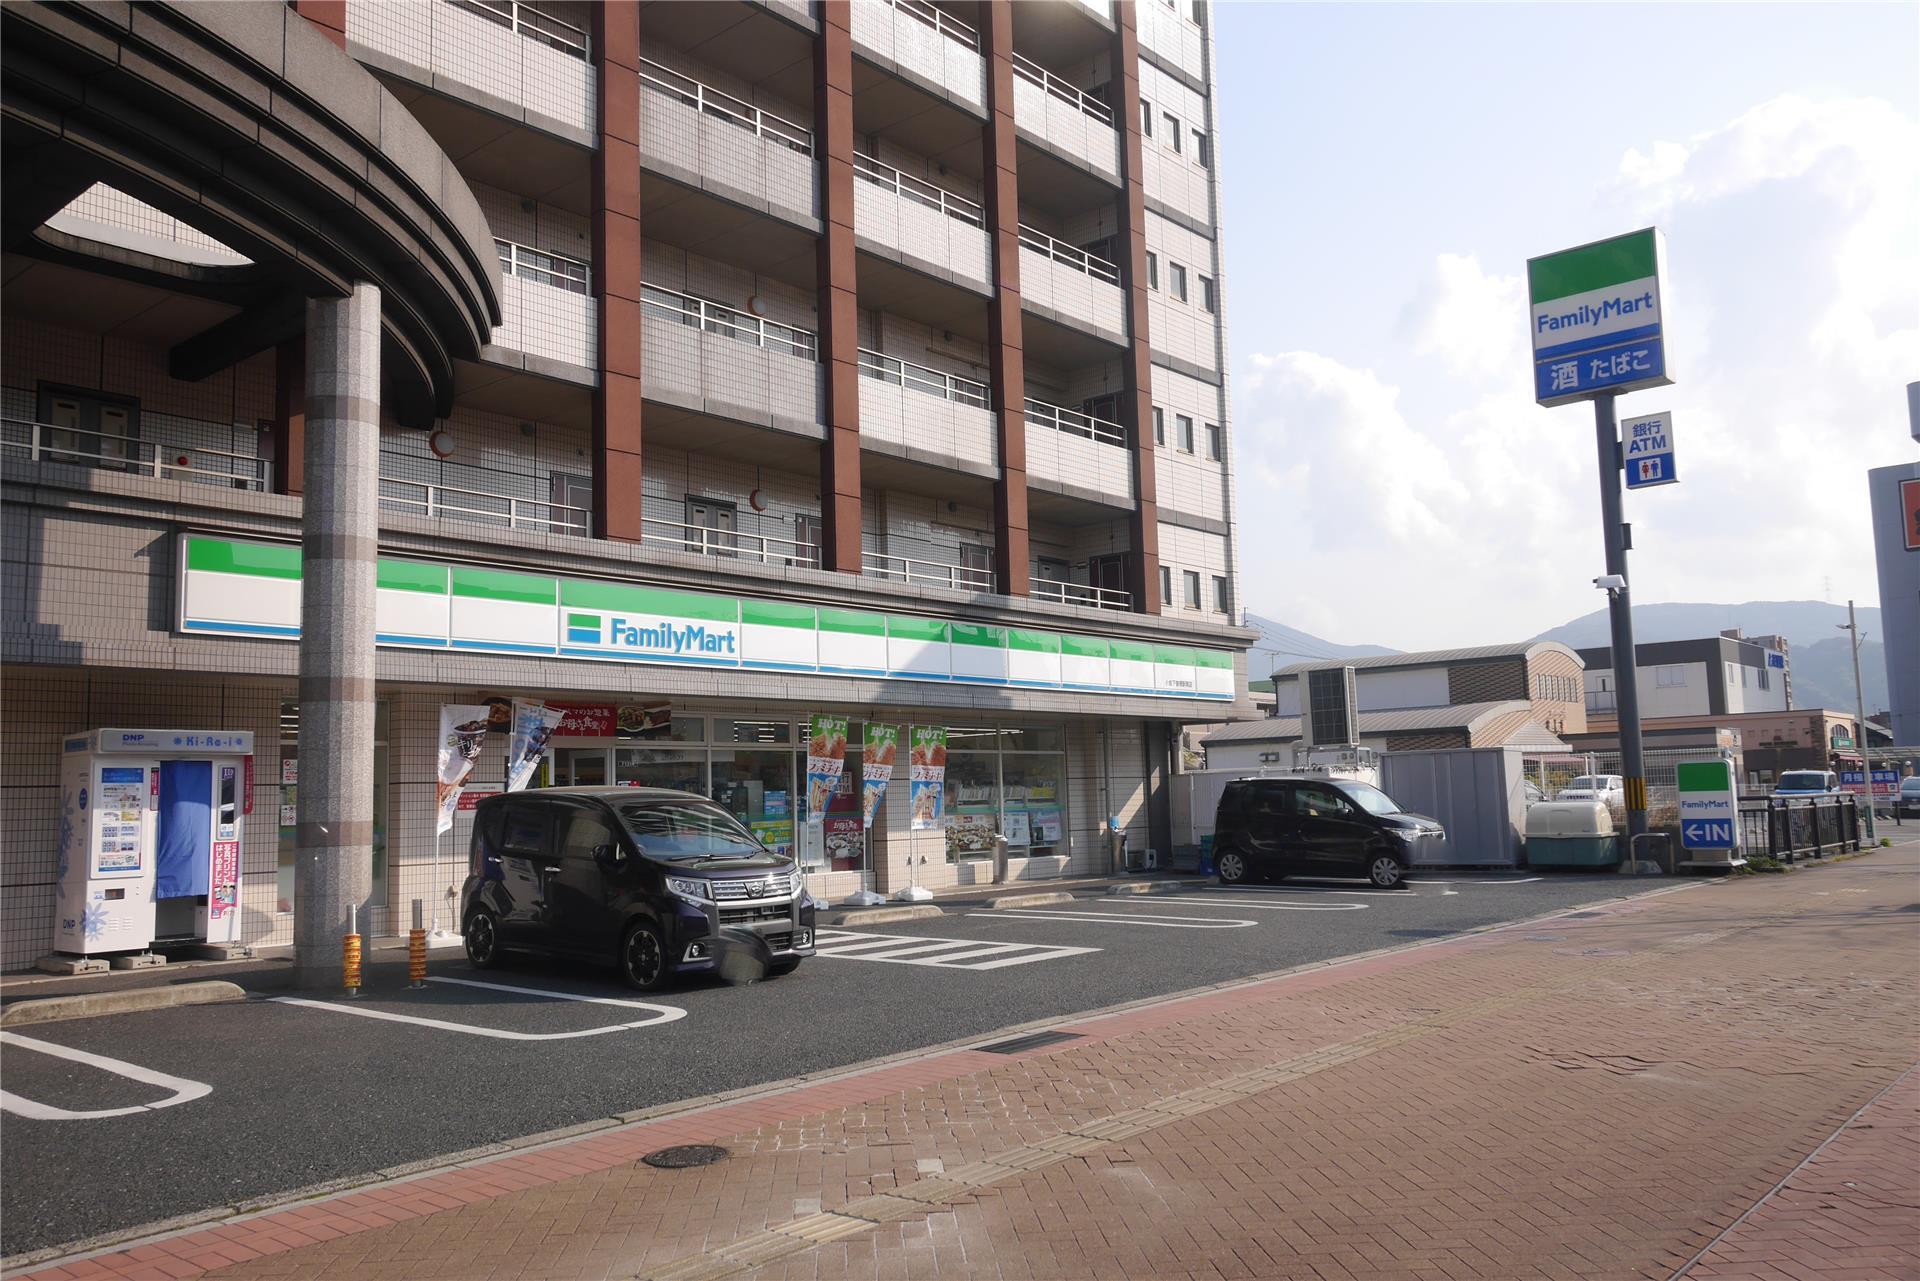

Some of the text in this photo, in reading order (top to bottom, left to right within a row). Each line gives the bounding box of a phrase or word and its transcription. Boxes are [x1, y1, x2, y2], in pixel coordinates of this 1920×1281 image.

[1537, 292, 1653, 333] FamilyMart
[1550, 350, 1651, 391] 酒 たばこ
[1632, 420, 1662, 437] 銀行
[1629, 434, 1667, 453] ATM
[611, 617, 735, 654] FamilyMart
[818, 718, 846, 730] HOT!
[871, 726, 895, 738] HOT!
[122, 734, 145, 742] DNP
[916, 729, 943, 740] HOT!
[1843, 772, 1896, 782] 月極車場
[1681, 801, 1729, 810] FamilyMart
[1704, 823, 1730, 841] IN
[214, 843, 223, 885] はじめました
